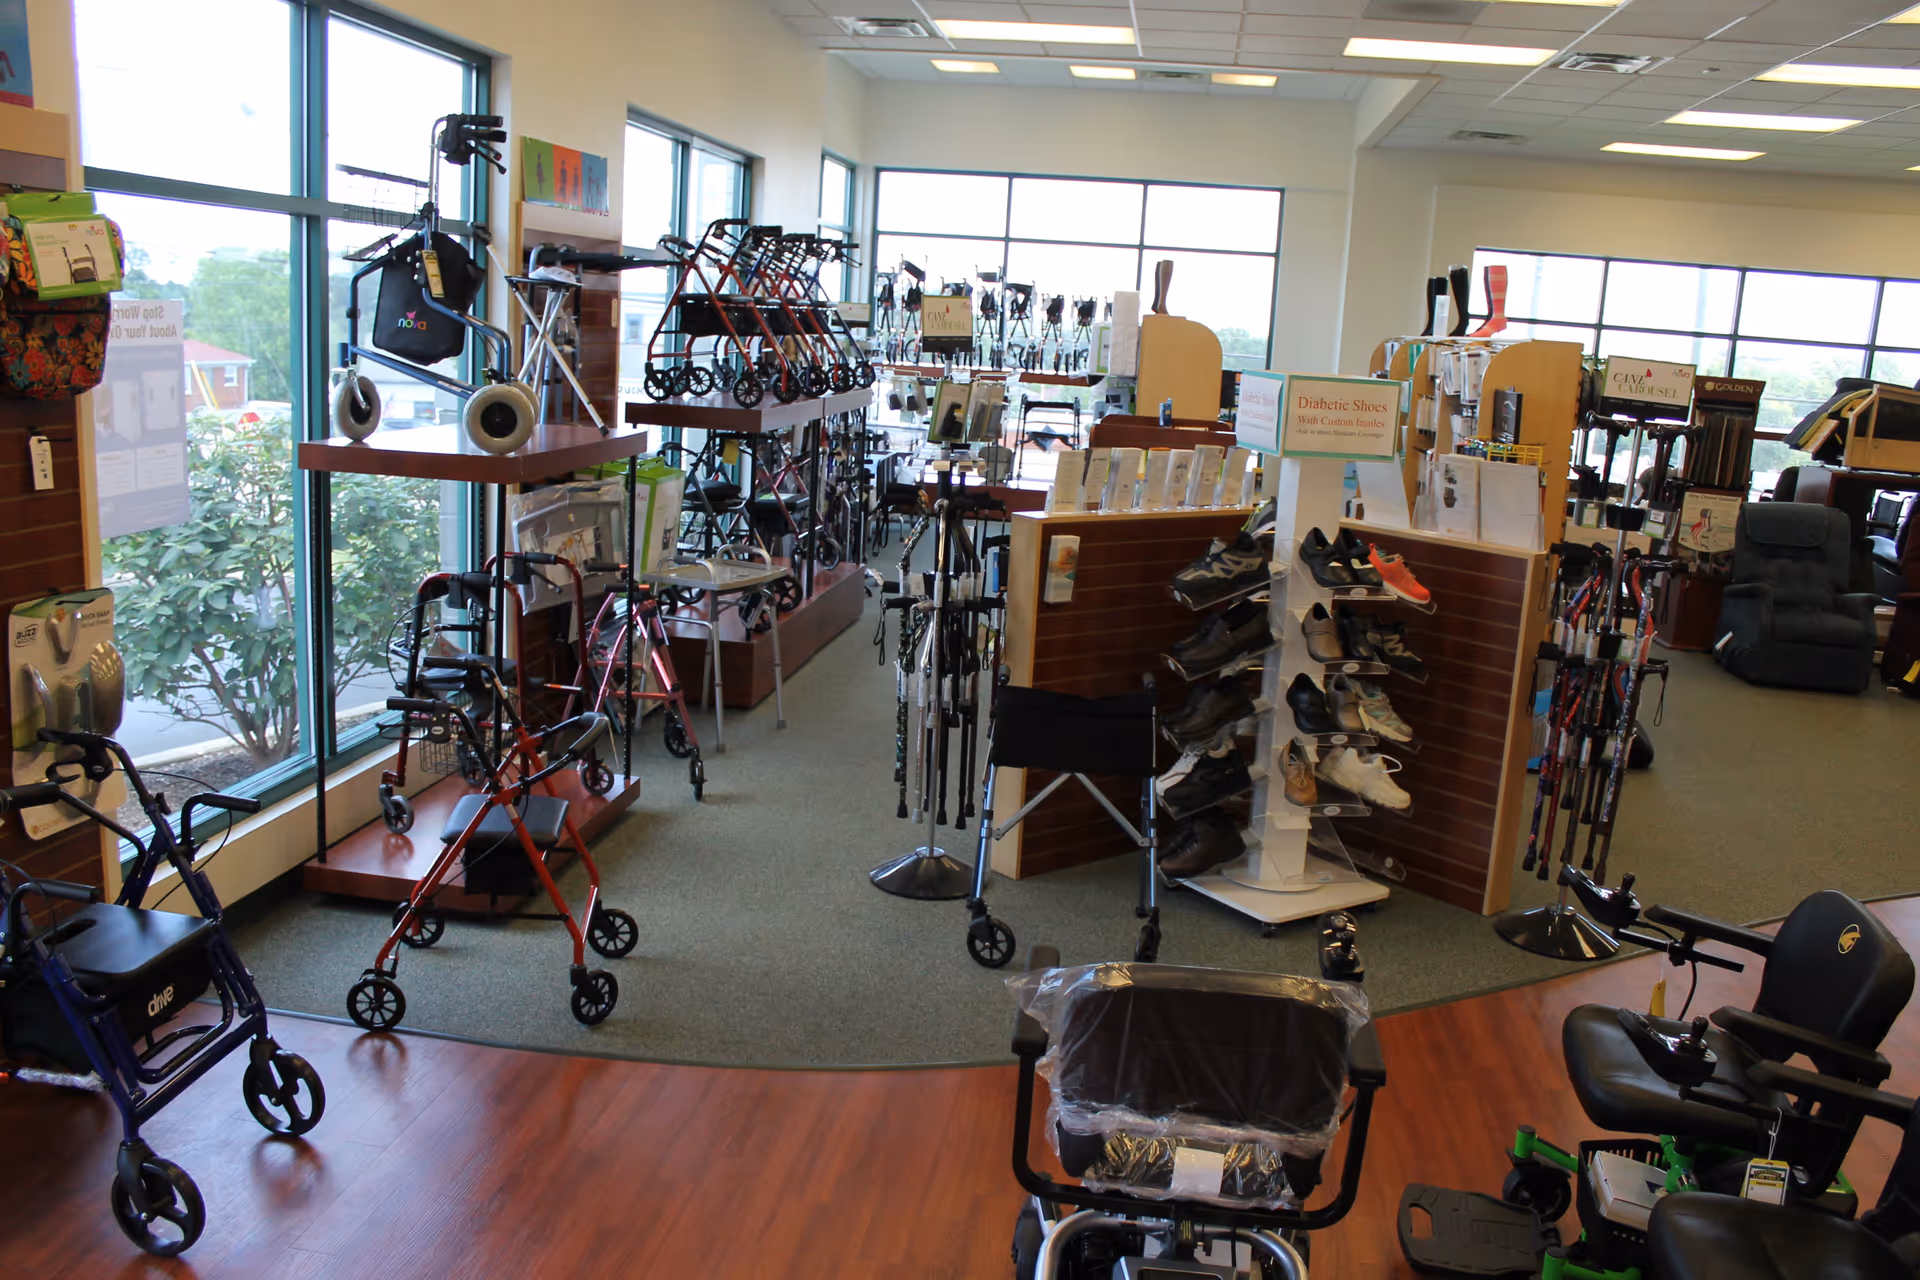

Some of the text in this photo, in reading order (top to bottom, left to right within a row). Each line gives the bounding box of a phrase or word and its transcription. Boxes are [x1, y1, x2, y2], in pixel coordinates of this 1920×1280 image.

[398, 317, 427, 331] nova
[1613, 372, 1648, 386] CANE
[1617, 383, 1680, 399] CAROUSEL
[1715, 383, 1754, 394] GOLDEN
[1298, 396, 1388, 413] Diabetic Shoes
[1297, 415, 1385, 428] With Custom Insoles
[16, 628, 37, 639] BUZZ
[147, 985, 174, 1017] drive
